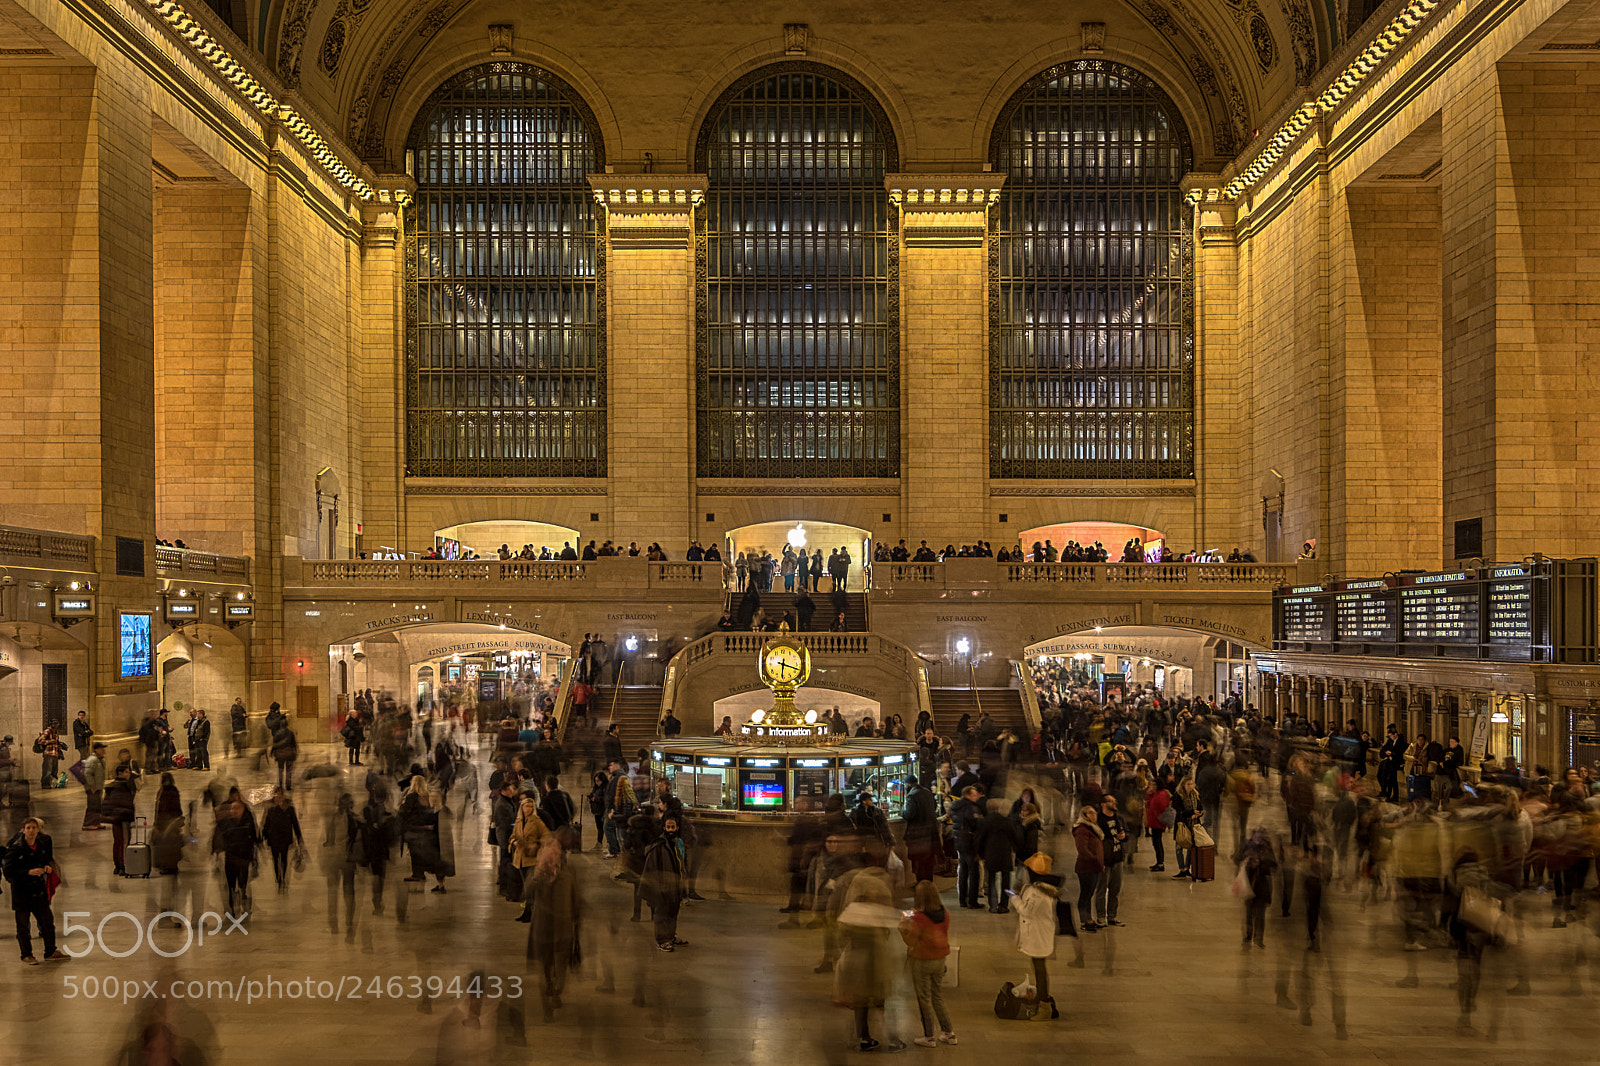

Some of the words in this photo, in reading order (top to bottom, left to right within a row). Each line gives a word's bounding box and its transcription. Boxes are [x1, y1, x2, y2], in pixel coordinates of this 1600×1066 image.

[1494, 568, 1524, 577] INFORMATION
[366, 616, 400, 629] TRACKS
[466, 613, 520, 626] LEXINGTON
[523, 622, 540, 631] AVE
[1056, 616, 1111, 633] LEXINGTON
[1113, 615, 1131, 623] AVE
[1164, 615, 1196, 625] TICKET
[1199, 620, 1246, 636] MACHINES
[449, 642, 475, 651] STREET
[515, 641, 545, 649] SUBWAY
[1036, 644, 1064, 654] STREET
[1103, 643, 1136, 652] SUBWAY
[814, 680, 838, 688] DINING
[839, 683, 876, 697] CONCOURSE
[1558, 680, 1595, 688] CUSTOMER
[769, 728, 811, 736] Information
